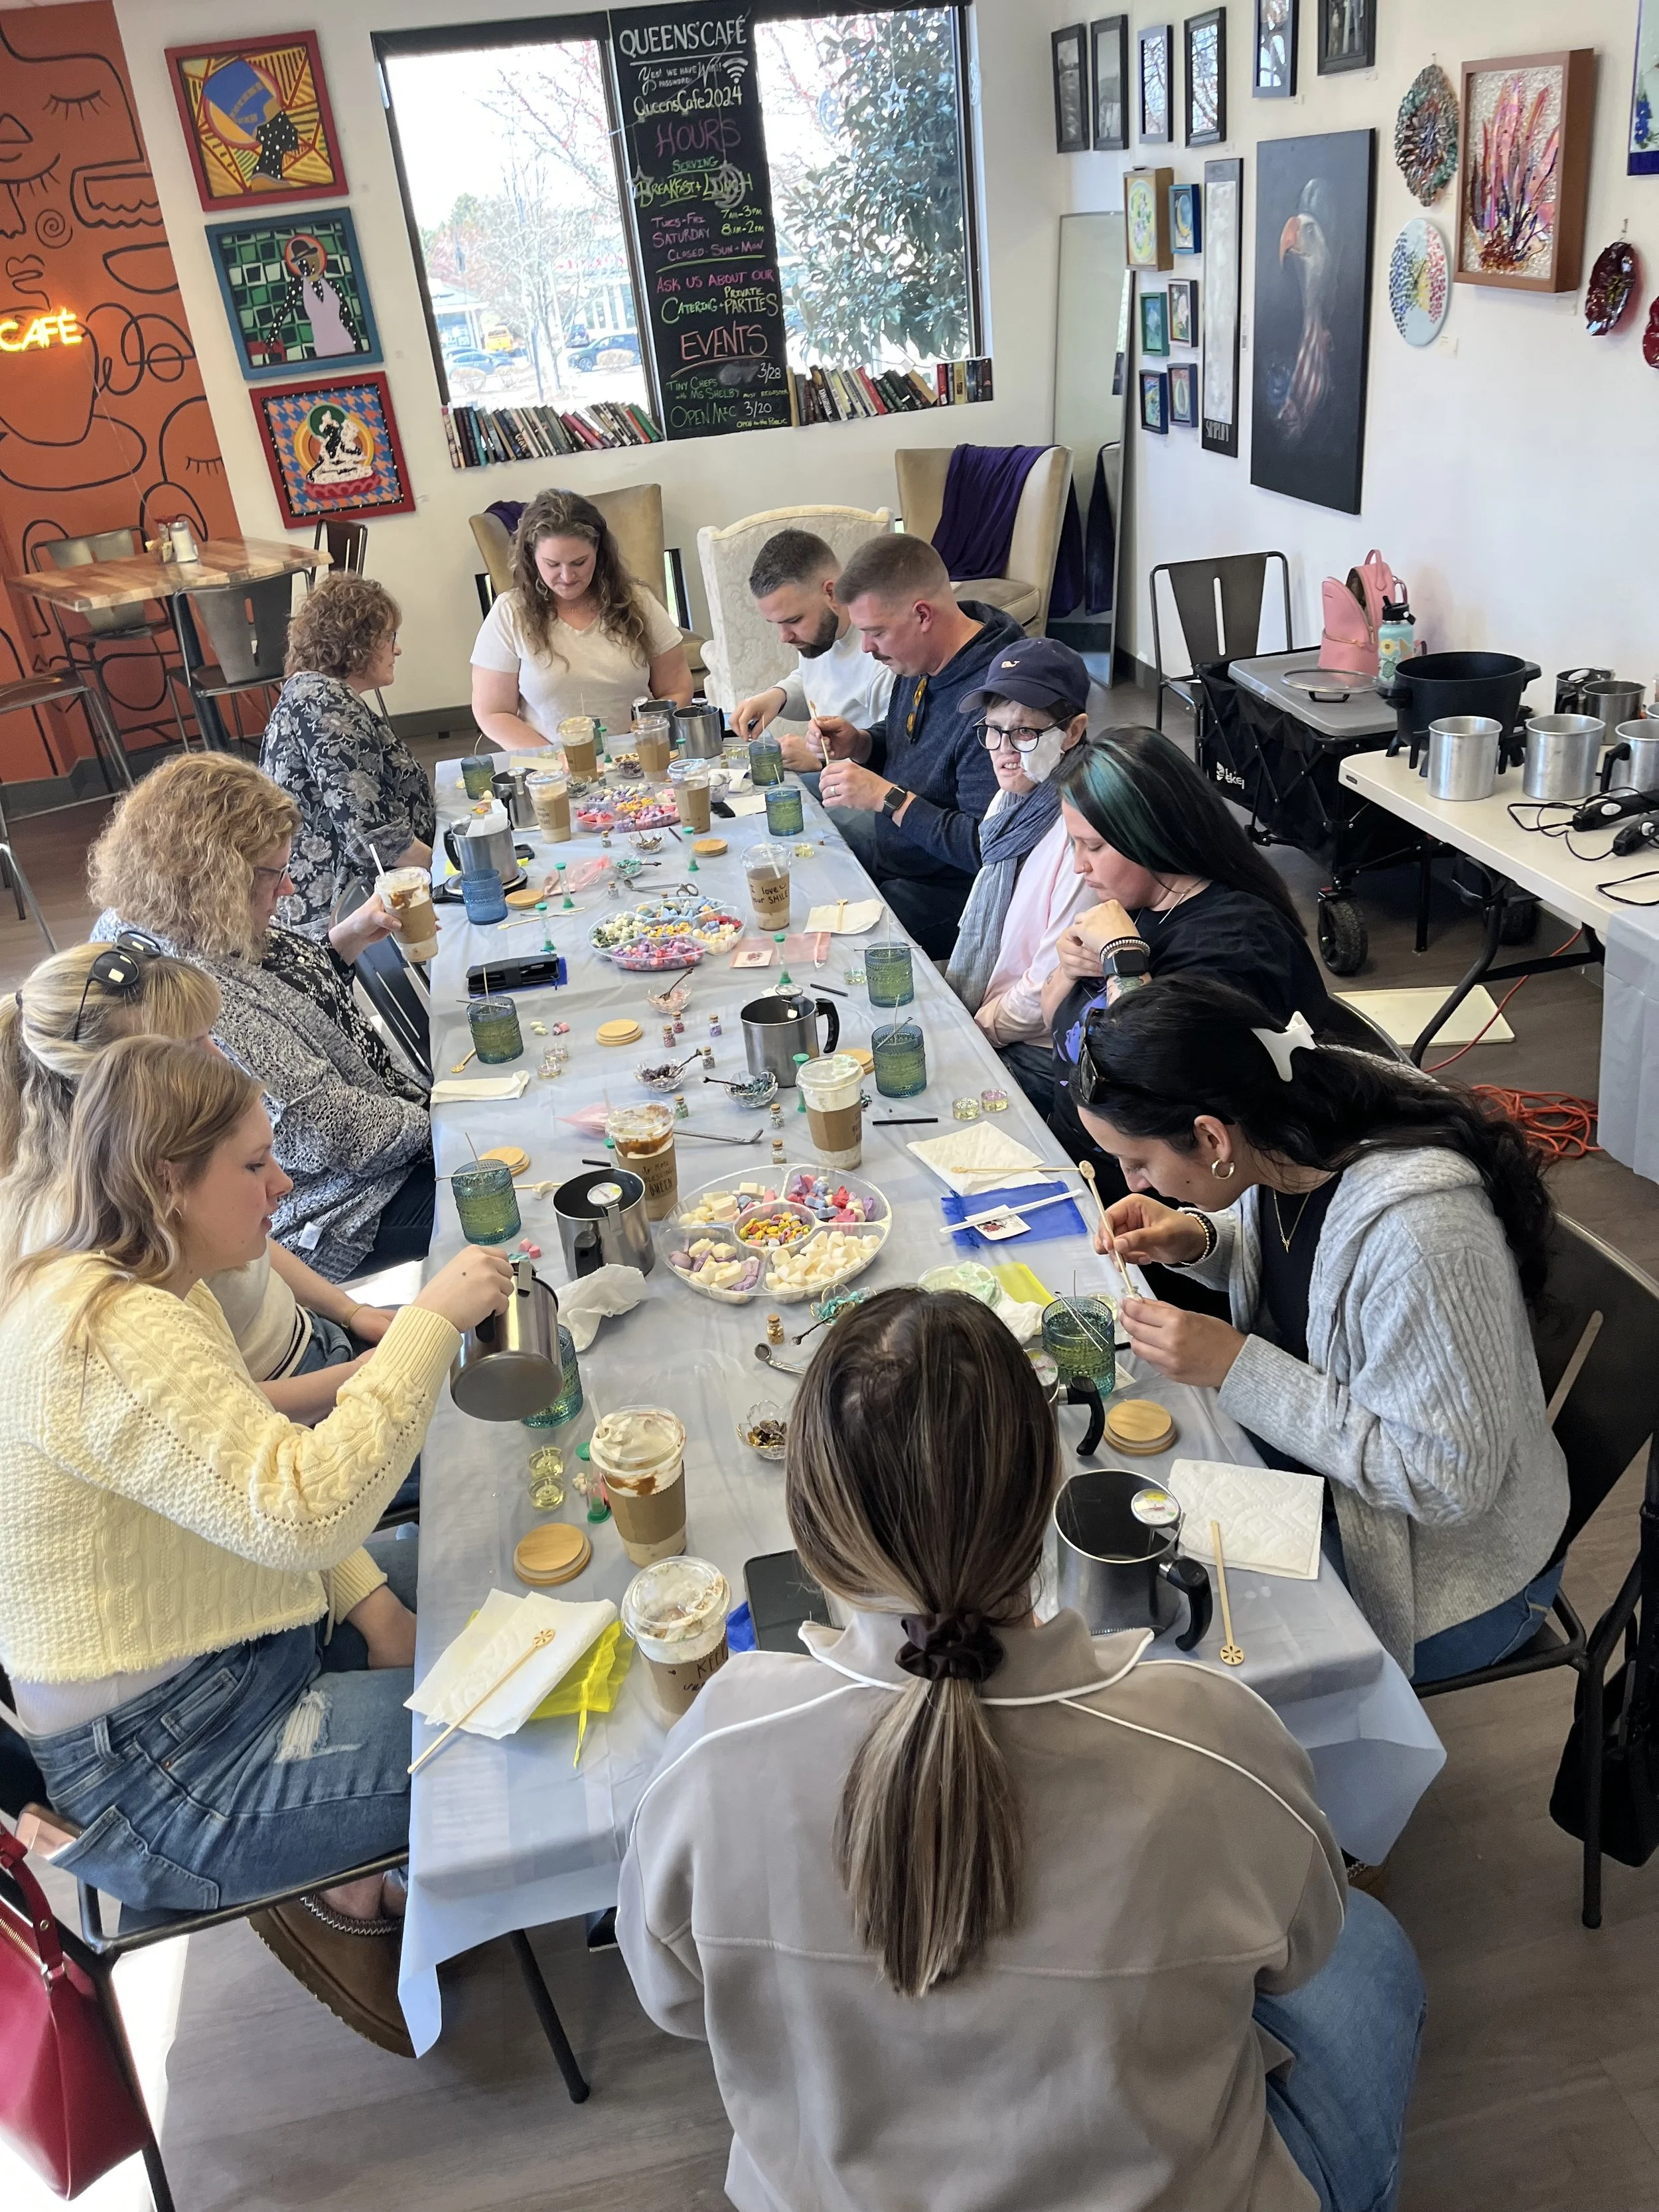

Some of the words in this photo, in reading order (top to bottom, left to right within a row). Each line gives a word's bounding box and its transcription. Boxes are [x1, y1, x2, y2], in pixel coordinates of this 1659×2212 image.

[700, 15, 747, 47] CAFÉ
[666, 68, 678, 77] WE
[680, 66, 697, 74] HAVE
[634, 85, 743, 116] QueensCafe2024
[656, 118, 742, 157] HOURS
[672, 156, 719, 173] SERVING
[652, 228, 710, 248] SATURDAY
[657, 275, 681, 293] ASK
[686, 275, 703, 288] US
[708, 271, 748, 287] ABOUT
[752, 269, 774, 281] OUR
[724, 285, 764, 298] PRIVATE
[661, 297, 718, 324] CATERING
[724, 293, 778, 317] PARTIES
[680, 320, 768, 360] EVENTS
[757, 362, 782, 384] 3/28
[671, 402, 710, 427] OPEN
[744, 401, 772, 418] 3/20
[768, 889, 788, 904] SMILE
